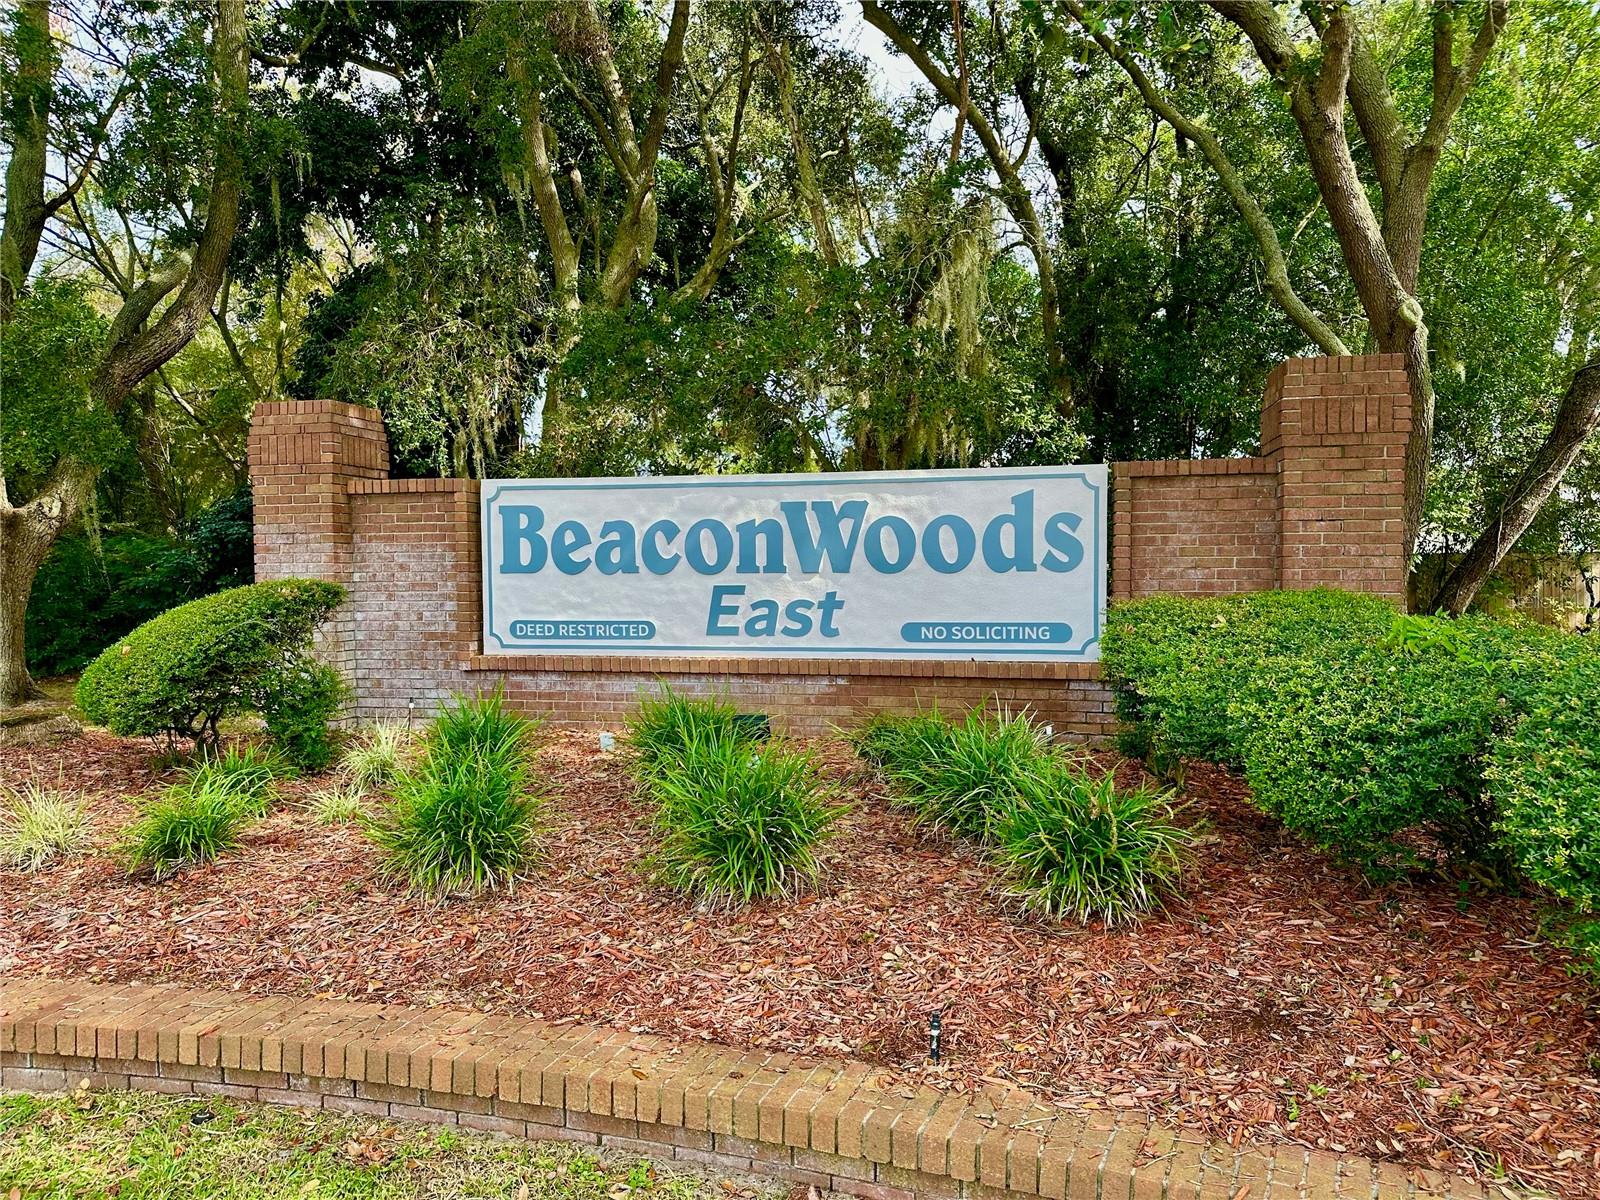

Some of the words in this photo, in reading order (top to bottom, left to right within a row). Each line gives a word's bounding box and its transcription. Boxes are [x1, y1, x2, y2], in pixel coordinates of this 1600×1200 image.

[499, 490, 1084, 576] BeaconWoods
[706, 584, 845, 638] East
[516, 623, 555, 636] DEED
[559, 623, 649, 637] RESTRICTED
[920, 626, 947, 640] NO
[951, 626, 1051, 640] SOLICITING
